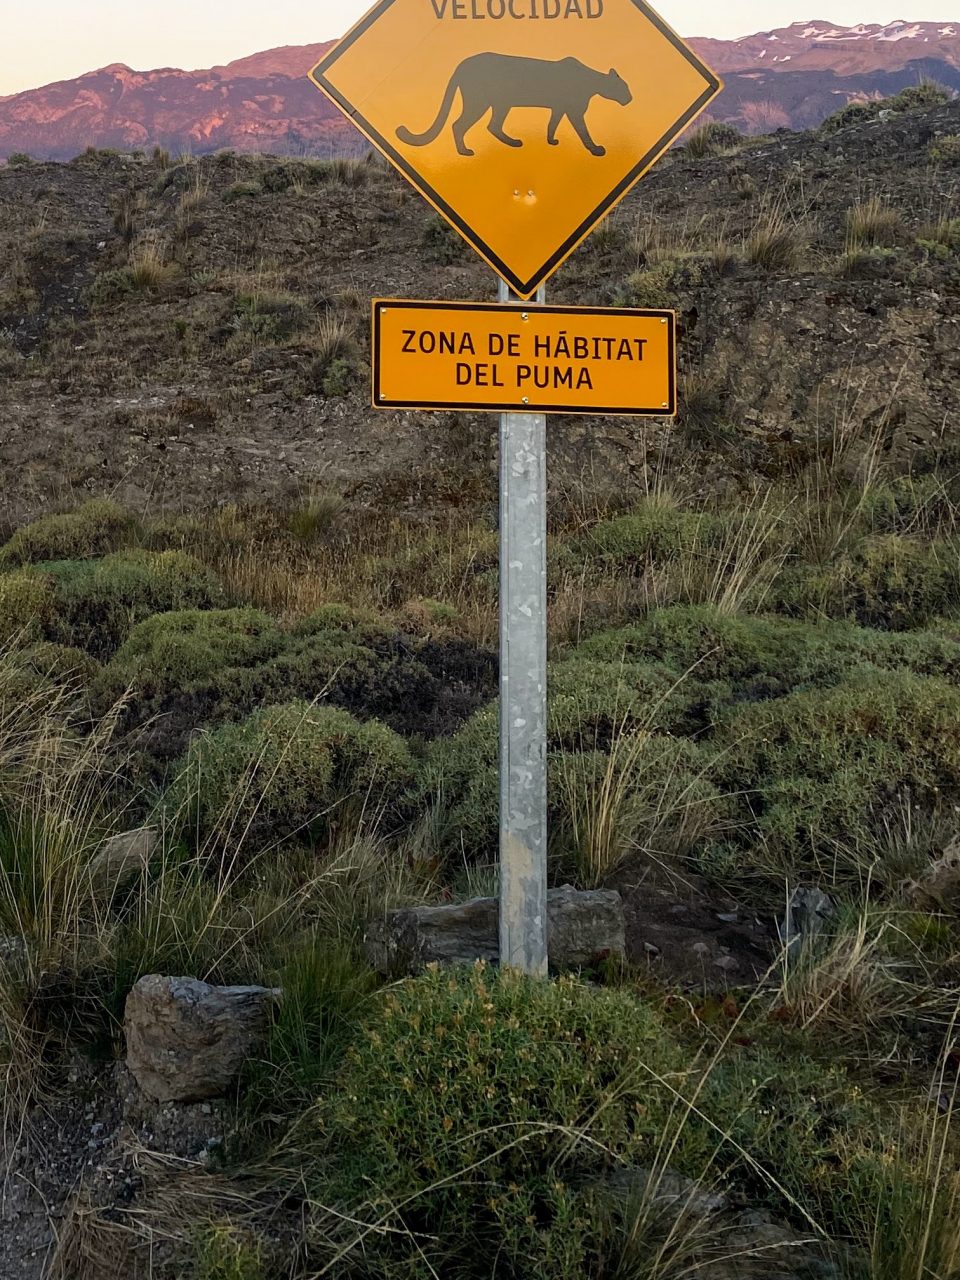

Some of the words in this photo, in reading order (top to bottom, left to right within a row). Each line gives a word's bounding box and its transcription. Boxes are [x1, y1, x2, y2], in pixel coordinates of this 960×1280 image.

[401, 329, 476, 355] ZONA
[488, 333, 521, 357] DE
[534, 330, 648, 361] HÁBITAT
[455, 362, 504, 387] DEL
[516, 364, 593, 390] PUMA
